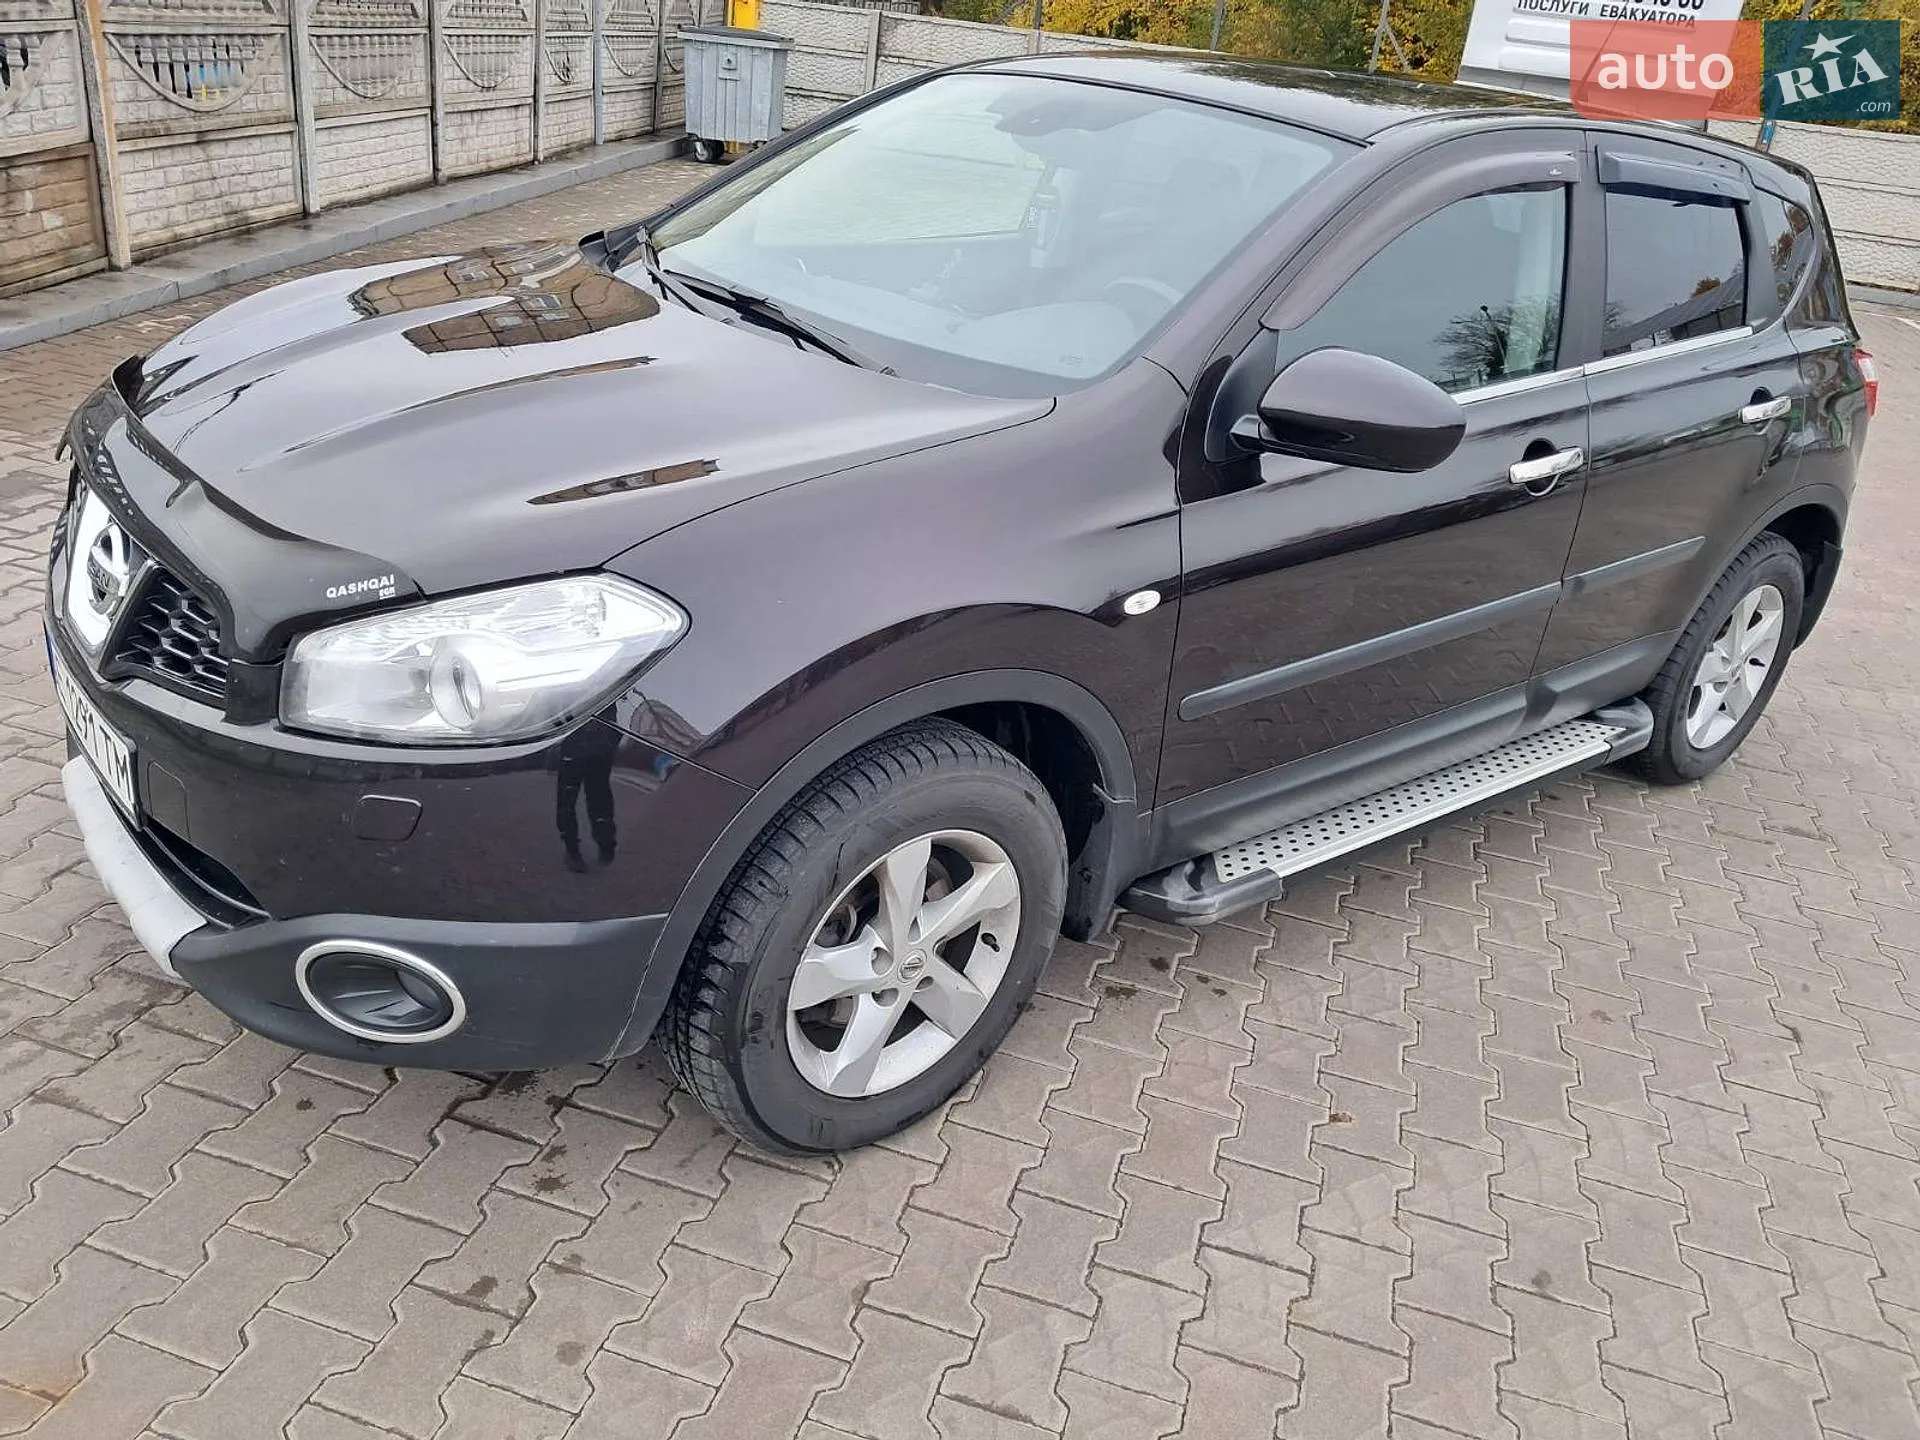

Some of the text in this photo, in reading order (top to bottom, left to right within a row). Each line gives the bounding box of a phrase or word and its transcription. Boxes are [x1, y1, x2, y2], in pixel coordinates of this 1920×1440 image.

[1517, 0, 1589, 15] ПОСЛУГИ
[1599, 4, 1696, 29] ЕВАКУАТОРА
[326, 573, 395, 598] QASHQAI
